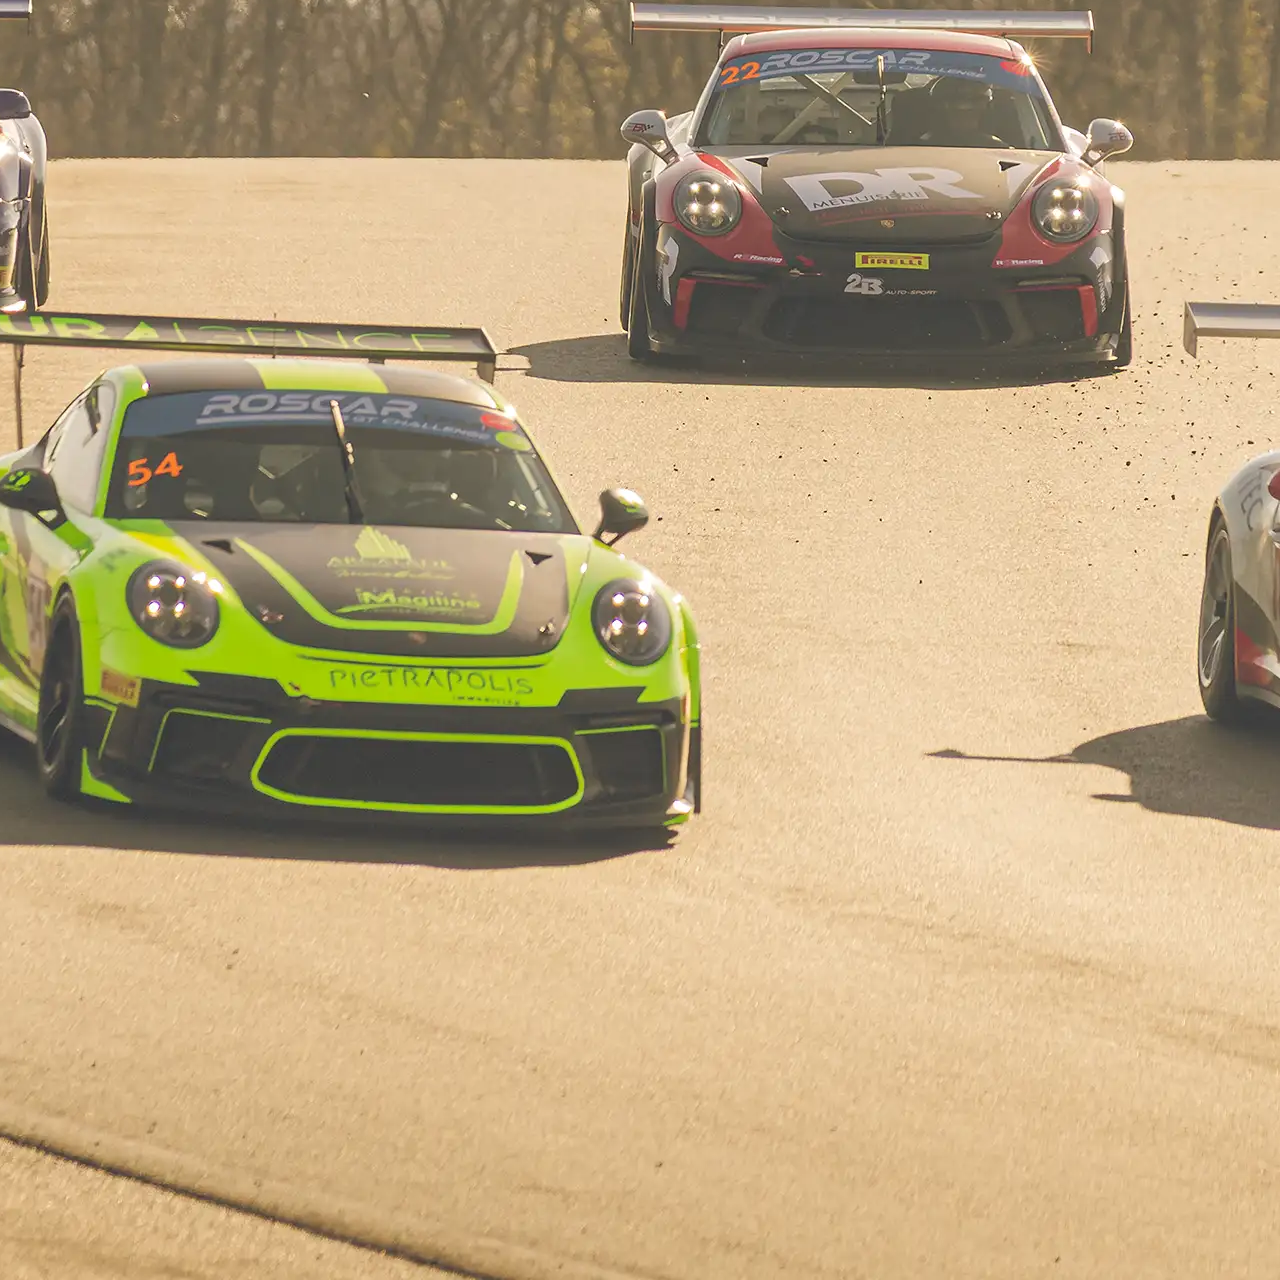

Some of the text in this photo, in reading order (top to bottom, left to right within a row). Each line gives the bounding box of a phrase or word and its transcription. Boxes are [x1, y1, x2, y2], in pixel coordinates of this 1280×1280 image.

[759, 49, 932, 71] ROSCAR
[720, 61, 761, 87] 22
[783, 166, 985, 212] DR
[201, 393, 418, 418] ROSCAR
[127, 451, 184, 487] 54
